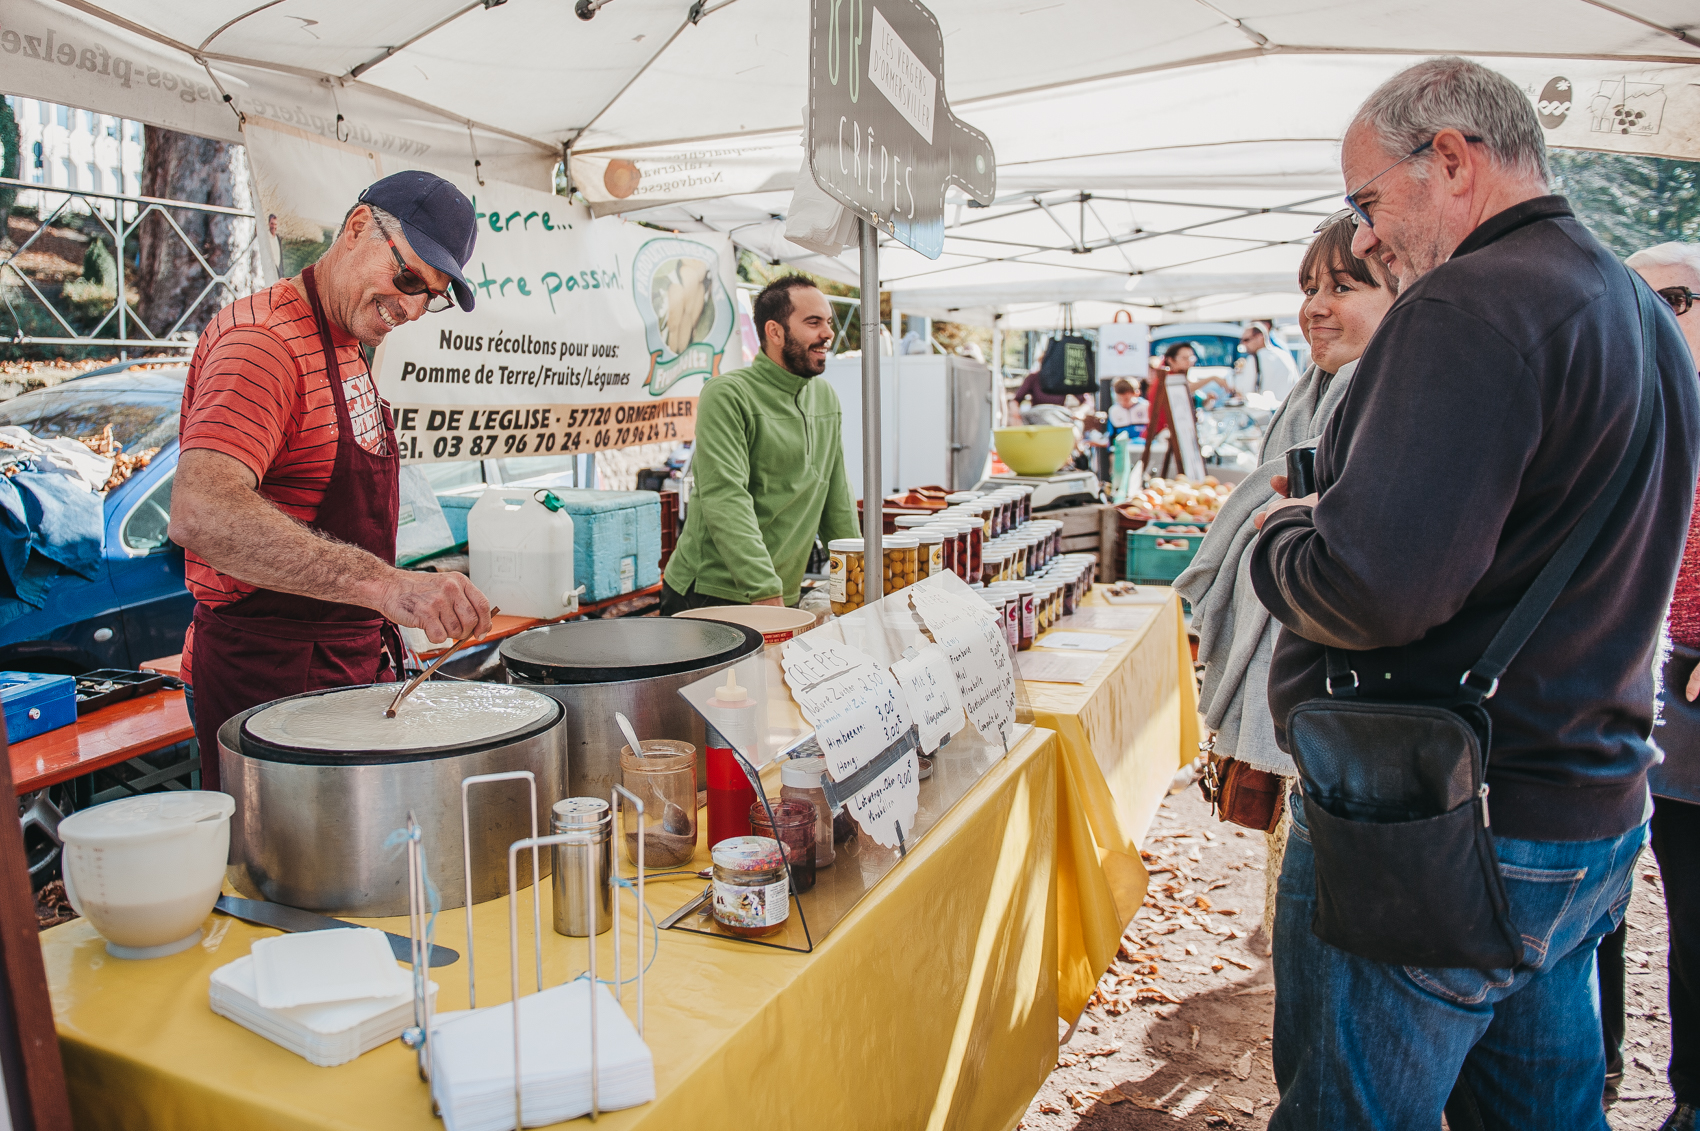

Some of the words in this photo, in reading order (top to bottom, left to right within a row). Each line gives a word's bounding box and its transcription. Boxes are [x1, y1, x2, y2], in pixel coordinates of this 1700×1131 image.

[881, 26, 894, 60] LES
[897, 46, 927, 97] VERGERS
[873, 49, 930, 131] D'ORMERSVILLER
[839, 115, 915, 219] CRÊPES
[541, 253, 624, 314] passion!
[439, 329, 483, 352] Nous
[487, 330, 556, 355] récoltons
[560, 342, 589, 361] pour
[592, 344, 620, 359] vous:
[401, 361, 470, 384] Pomme
[475, 364, 493, 384] de
[498, 364, 630, 392] Terre/Fruits/Légumes
[426, 410, 464, 431] DE
[468, 408, 551, 431] L'EGLISE
[567, 407, 611, 428] 57720
[434, 436, 464, 459] 03
[469, 435, 499, 457] 87
[504, 434, 528, 455] 96
[533, 432, 556, 453] 70
[560, 432, 582, 451] 24
[594, 429, 610, 448] 06
[614, 428, 630, 446] 70
[631, 426, 644, 444] 96
[647, 424, 660, 441] 24
[664, 422, 677, 438] 73
[788, 649, 848, 686] CREPES
[911, 675, 925, 692] Mit
[801, 695, 833, 717] Nature
